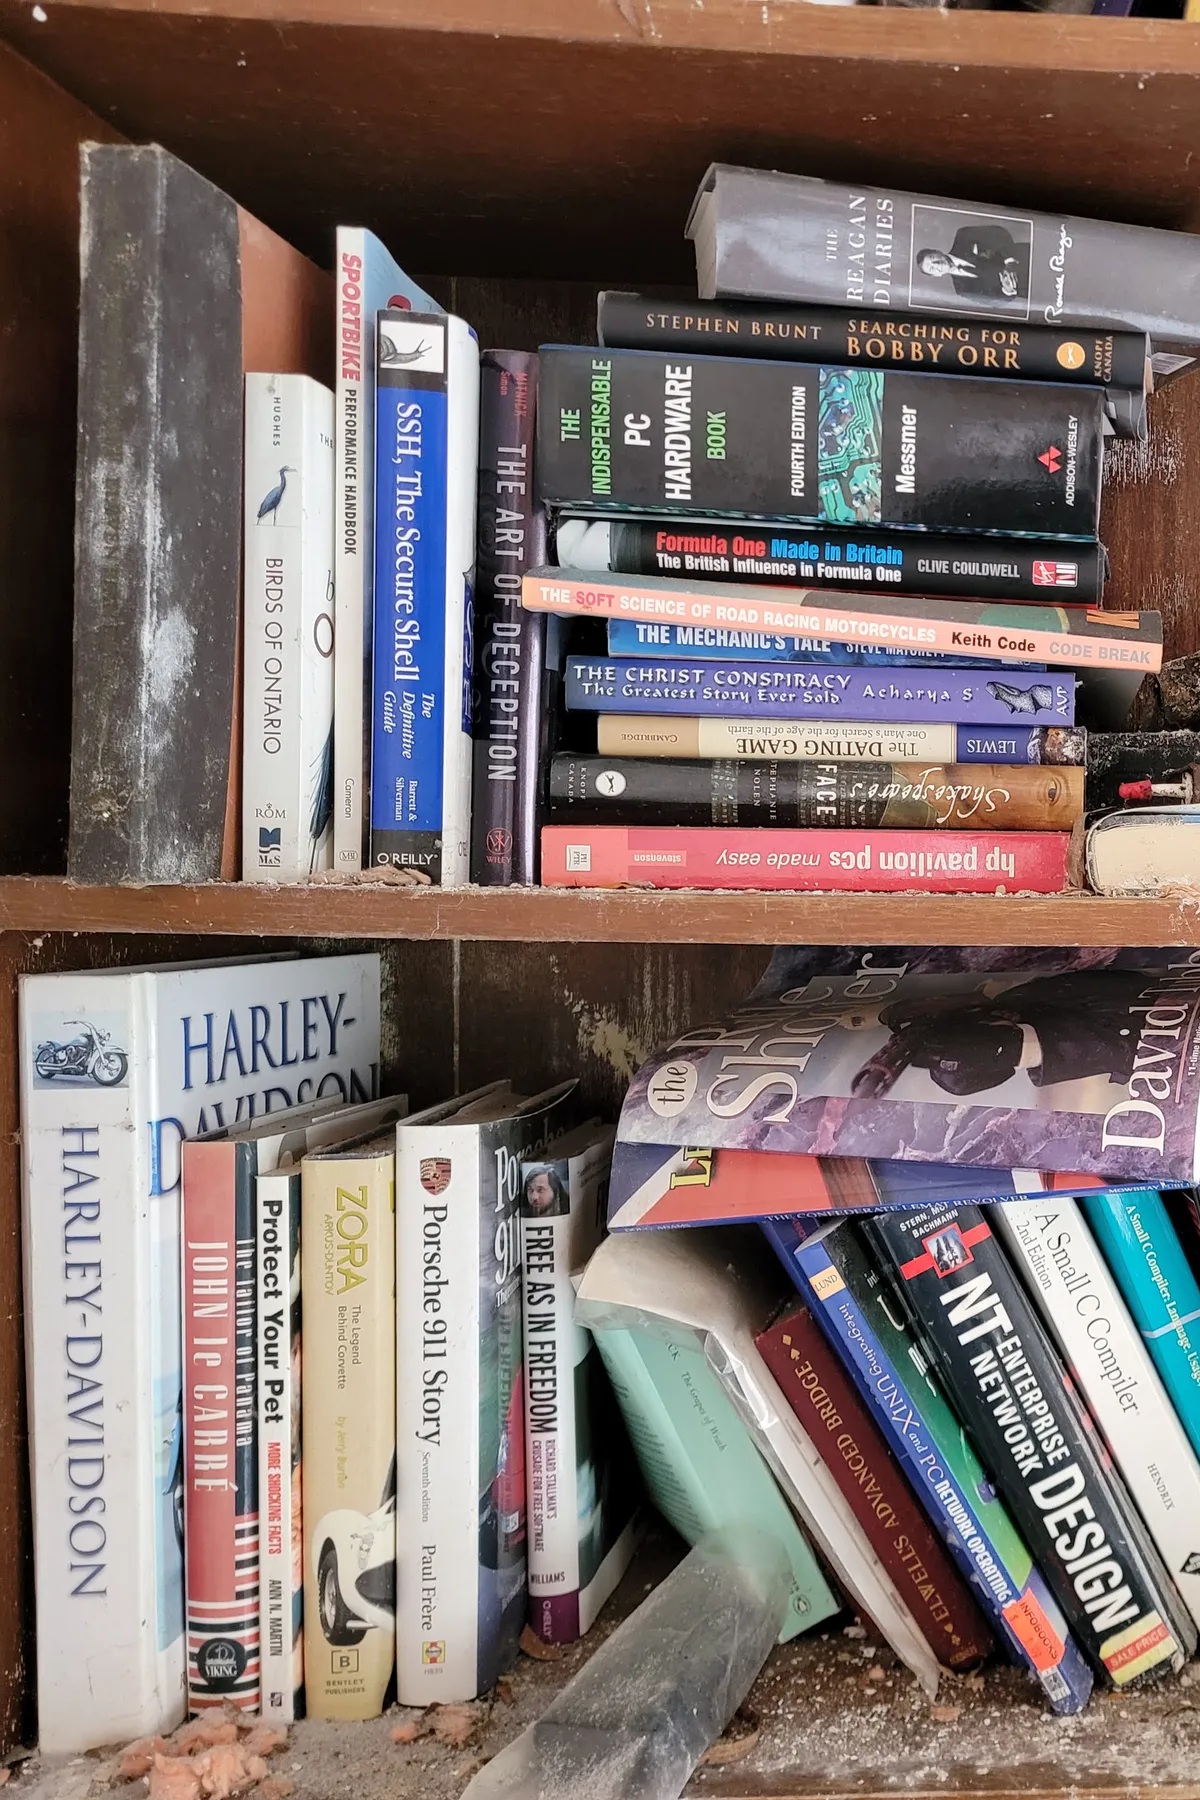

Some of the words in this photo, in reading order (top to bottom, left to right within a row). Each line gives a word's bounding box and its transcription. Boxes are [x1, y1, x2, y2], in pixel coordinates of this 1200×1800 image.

[826, 228, 837, 260] THE
[847, 193, 867, 302] REAGAN
[875, 197, 893, 305] DIARIES
[342, 253, 362, 382] SPORTBIKE
[647, 313, 739, 333] STEPHEN
[751, 320, 822, 340] BRUNT
[847, 337, 944, 363] BOBBY
[958, 347, 1021, 370] ORR
[1094, 339, 1103, 378] KNOPF
[1103, 335, 1113, 382] CANADA
[273, 396, 281, 447] HUGHES
[345, 389, 356, 480] PERFORMANCE
[393, 402, 422, 464] SSH,
[707, 410, 726, 460] BOOK
[396, 471, 422, 521] The
[345, 485, 356, 555] HANDBOOK
[265, 558, 284, 614] BIRDS
[395, 527, 422, 614] Secure
[657, 553, 681, 568] The
[685, 554, 730, 572] British
[734, 557, 796, 576] Influence
[800, 561, 813, 577] in
[817, 562, 872, 581] Formula
[875, 567, 901, 582] One
[918, 559, 950, 575] CLIVE
[952, 560, 1020, 578] COULDWELL
[264, 621, 283, 650] OF
[394, 619, 421, 681] Shell
[951, 631, 992, 649] Keith
[997, 636, 1036, 653] Code
[573, 665, 617, 682] THE
[625, 667, 705, 685] CHRIST
[714, 670, 851, 691] CONSPIRACY
[263, 656, 283, 754] ONTARIO
[383, 690, 397, 733] Guide
[402, 692, 416, 759] Definitive
[422, 692, 435, 719] The
[966, 739, 1016, 754] LEWIS
[344, 778, 355, 819] Cameron
[395, 777, 405, 821] Silverman
[408, 780, 418, 811] Barrett
[567, 763, 575, 803] CANADA
[753, 769, 761, 807] NOLEN
[769, 760, 777, 820] STEPHANIE
[816, 764, 837, 816] FACE
[408, 813, 418, 821] &
[258, 855, 281, 865] M&S
[486, 855, 511, 864] WILEY
[634, 852, 682, 863] stevenson
[653, 1065, 689, 1106] the
[262, 1200, 282, 1299] Protect
[336, 1186, 368, 1295] ZORA
[422, 1204, 449, 1313] Porsche
[337, 1305, 347, 1342] Behind
[352, 1305, 361, 1323] The
[264, 1309, 284, 1369] Your
[351, 1325, 361, 1365] Legend
[422, 1320, 448, 1362] 911
[62, 1125, 108, 1597] HARLEY-DAVIDSON
[337, 1345, 346, 1389] Corvette
[940, 1272, 1014, 1347] NT
[996, 1335, 1071, 1466] ENTERPRISE
[265, 1379, 284, 1423] Pet
[415, 1369, 449, 1447] Story
[794, 1361, 844, 1433] BRIDGE
[421, 1451, 430, 1491] Seventh
[836, 1434, 900, 1529] ADVANCED
[420, 1493, 429, 1522] edition
[421, 1544, 437, 1581] Paul
[1029, 1462, 1140, 1633] DESIGN
[269, 1579, 282, 1600] ANN
[894, 1533, 950, 1623] ELWELL'S
[269, 1603, 282, 1615] N.
[420, 1584, 436, 1631] Frère
[269, 1618, 283, 1656] MARTIN
[325, 1686, 365, 1695] PUBLISHERS
[326, 1678, 365, 1687] BENTLEY
